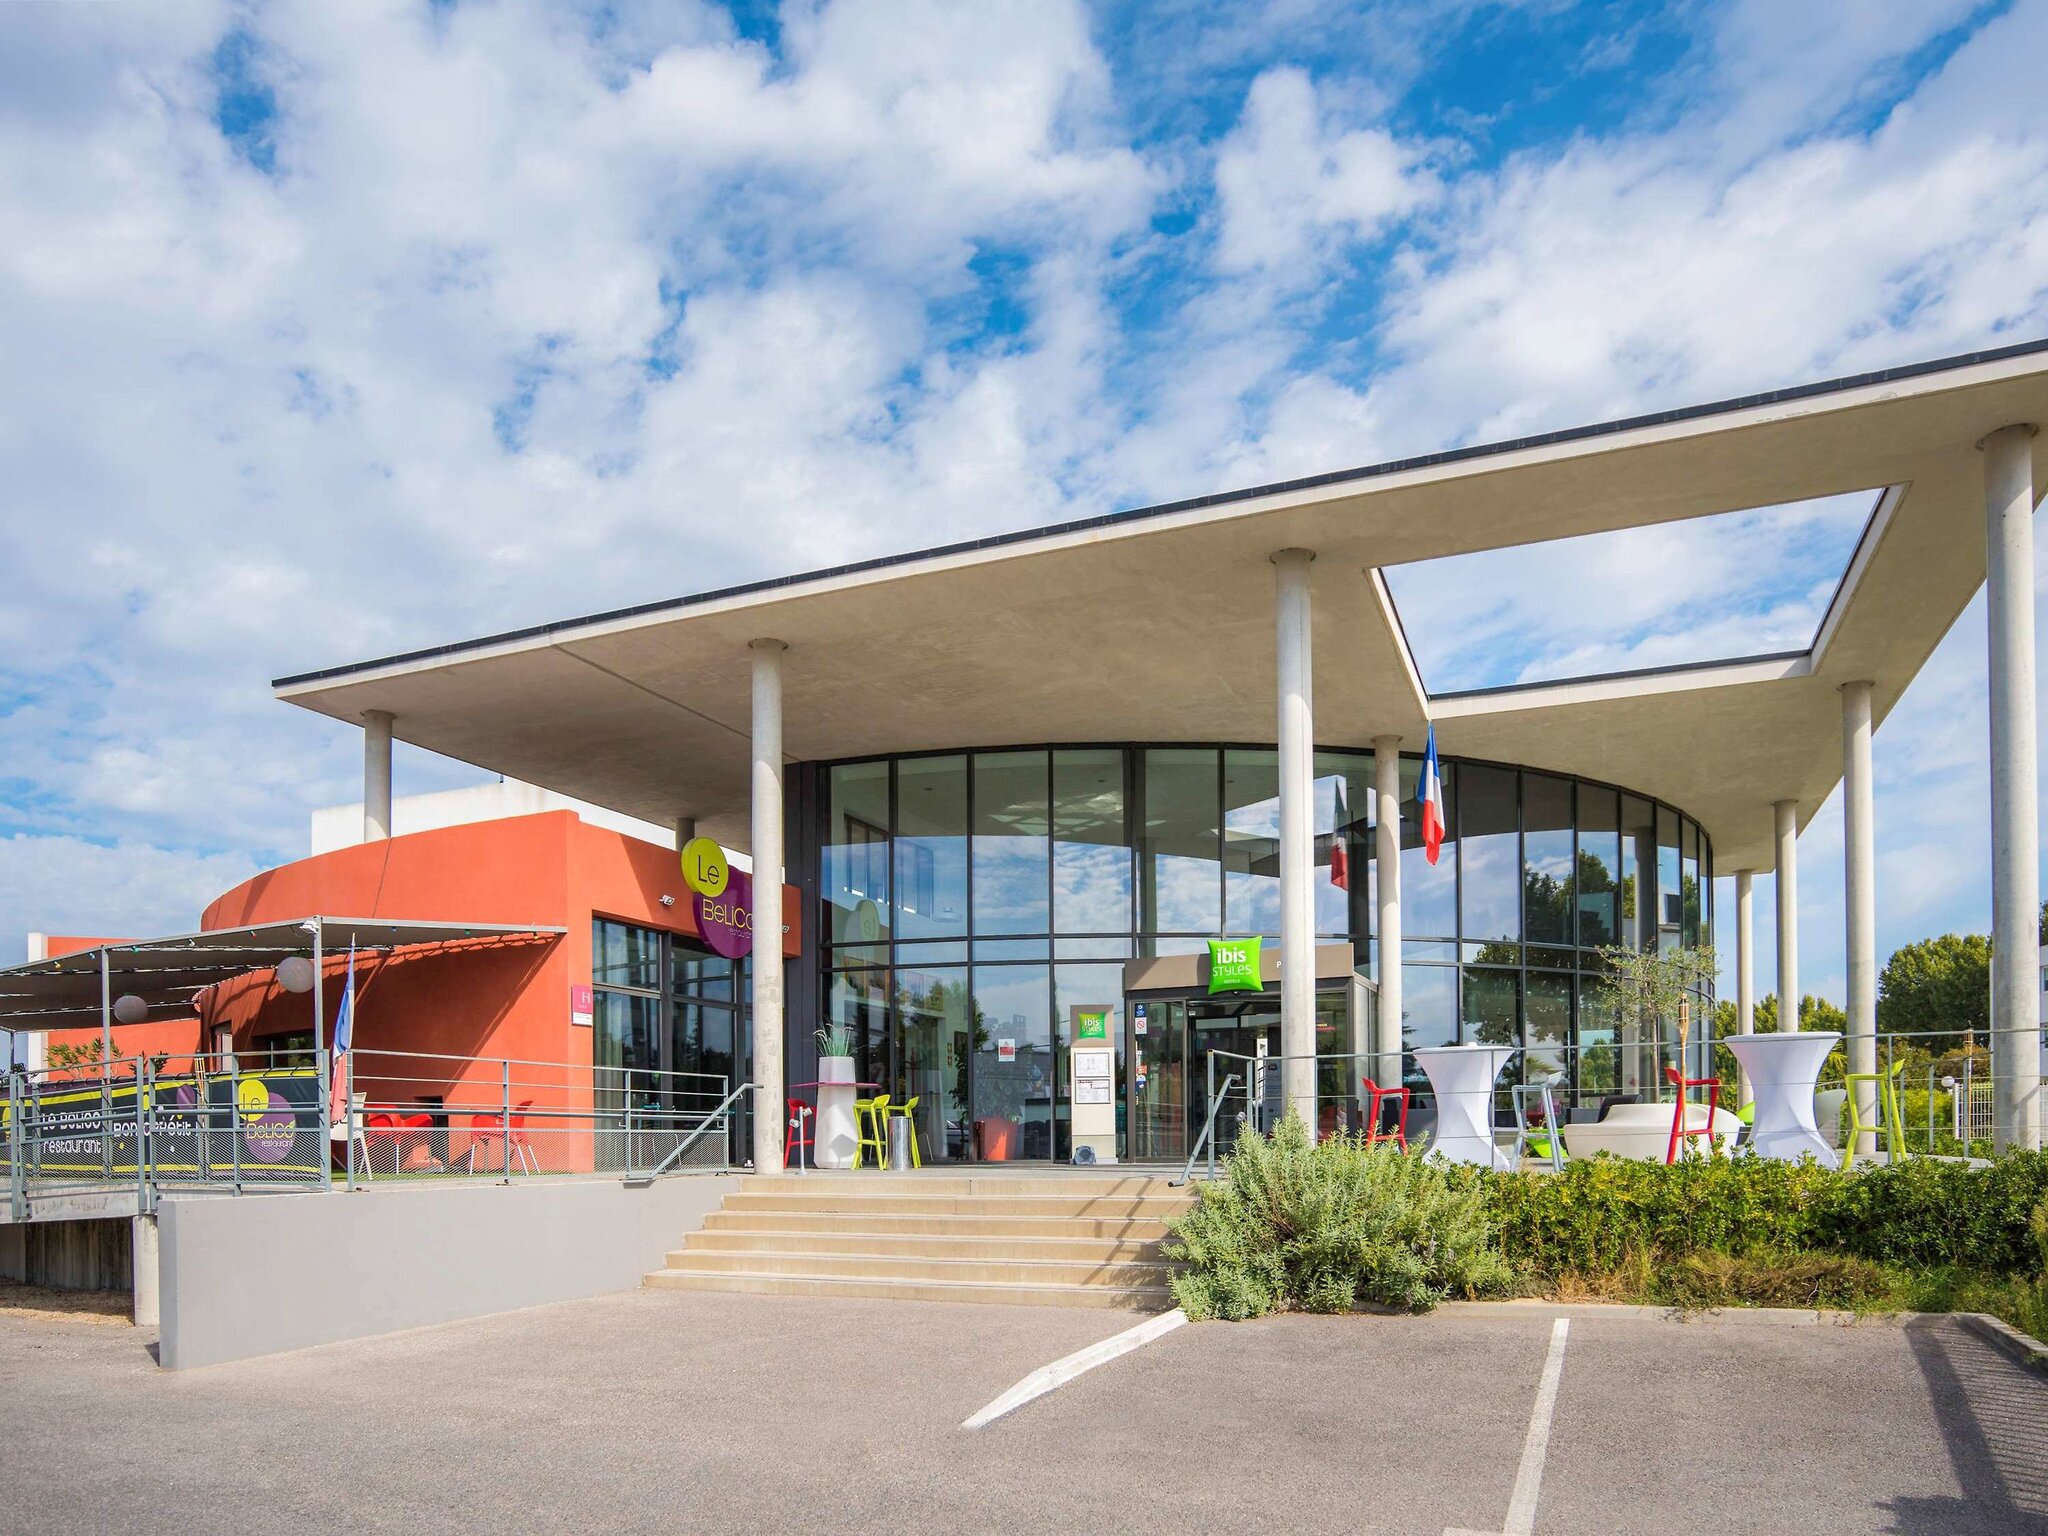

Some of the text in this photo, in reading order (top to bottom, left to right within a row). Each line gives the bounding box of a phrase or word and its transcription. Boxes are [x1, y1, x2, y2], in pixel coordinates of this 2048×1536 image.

[698, 854, 720, 885] Le
[1216, 947, 1247, 965] ibis
[1084, 1017, 1100, 1027] ibis
[43, 1139, 102, 1153] restaurant
